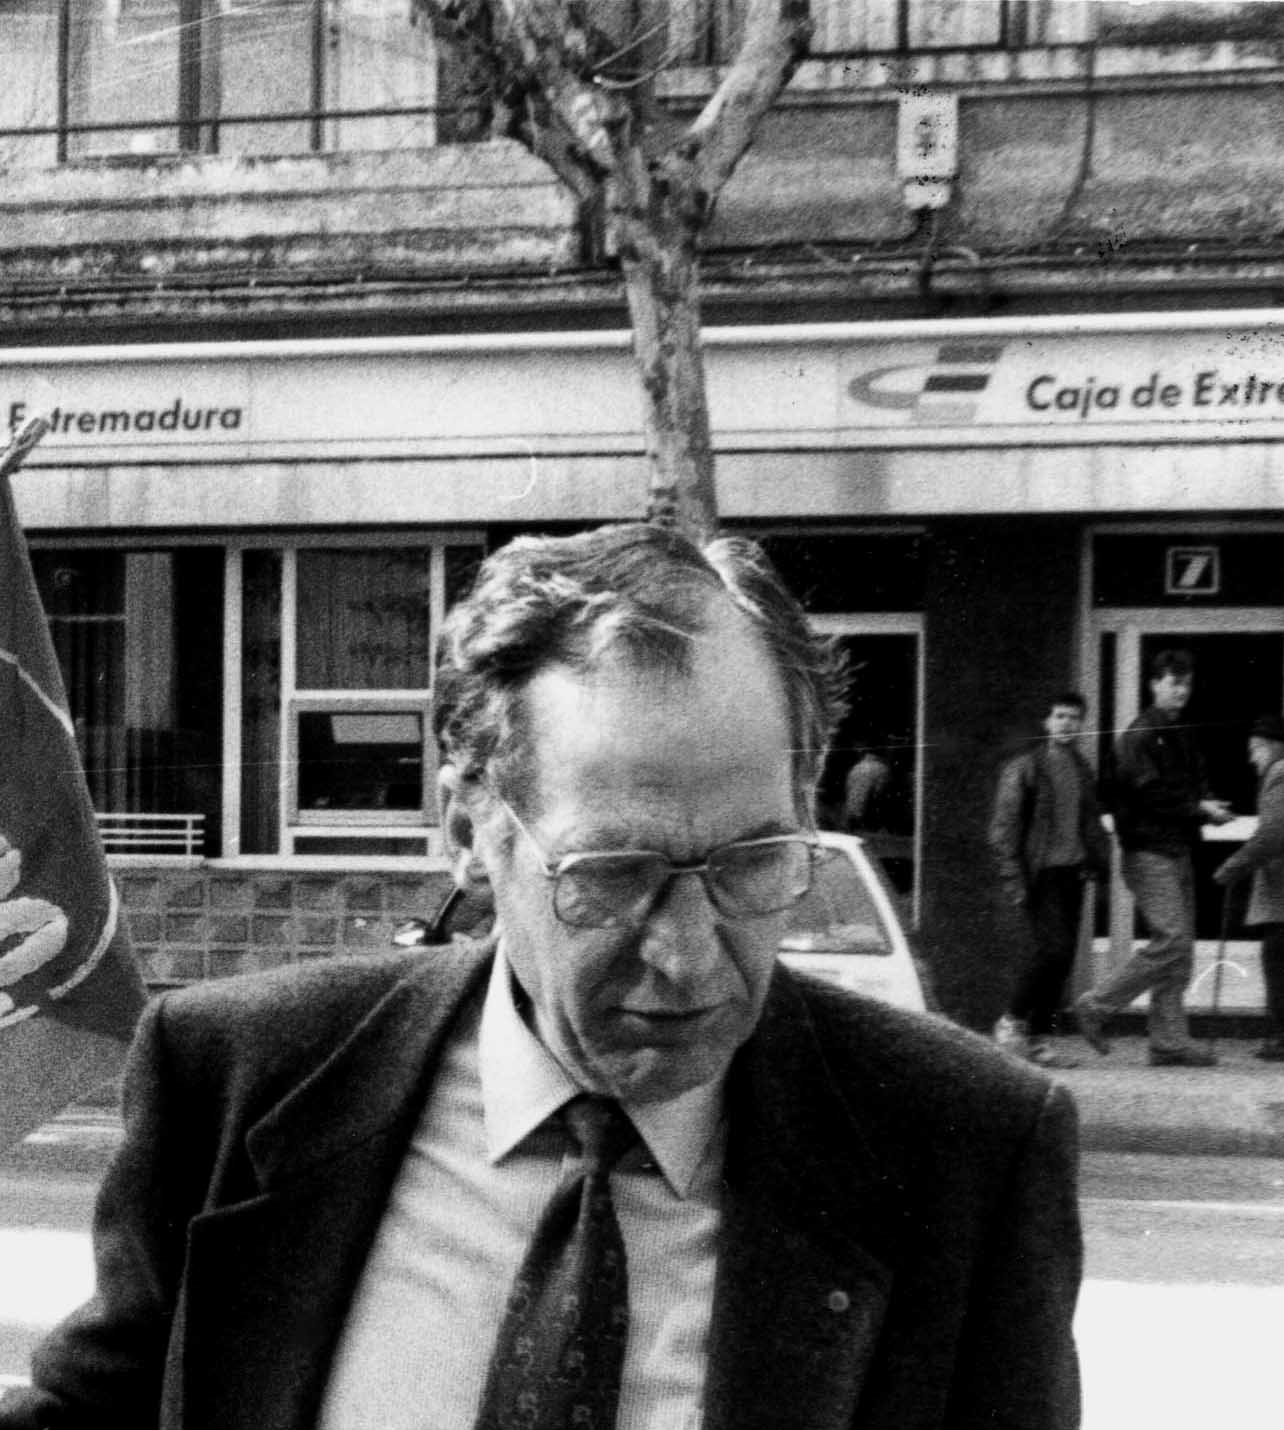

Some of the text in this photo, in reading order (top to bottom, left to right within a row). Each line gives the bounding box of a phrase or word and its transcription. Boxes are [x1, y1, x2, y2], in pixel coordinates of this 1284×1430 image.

[9, 397, 243, 434] Etremadura
[1025, 374, 1121, 419] Caja
[1131, 370, 1182, 409] de
